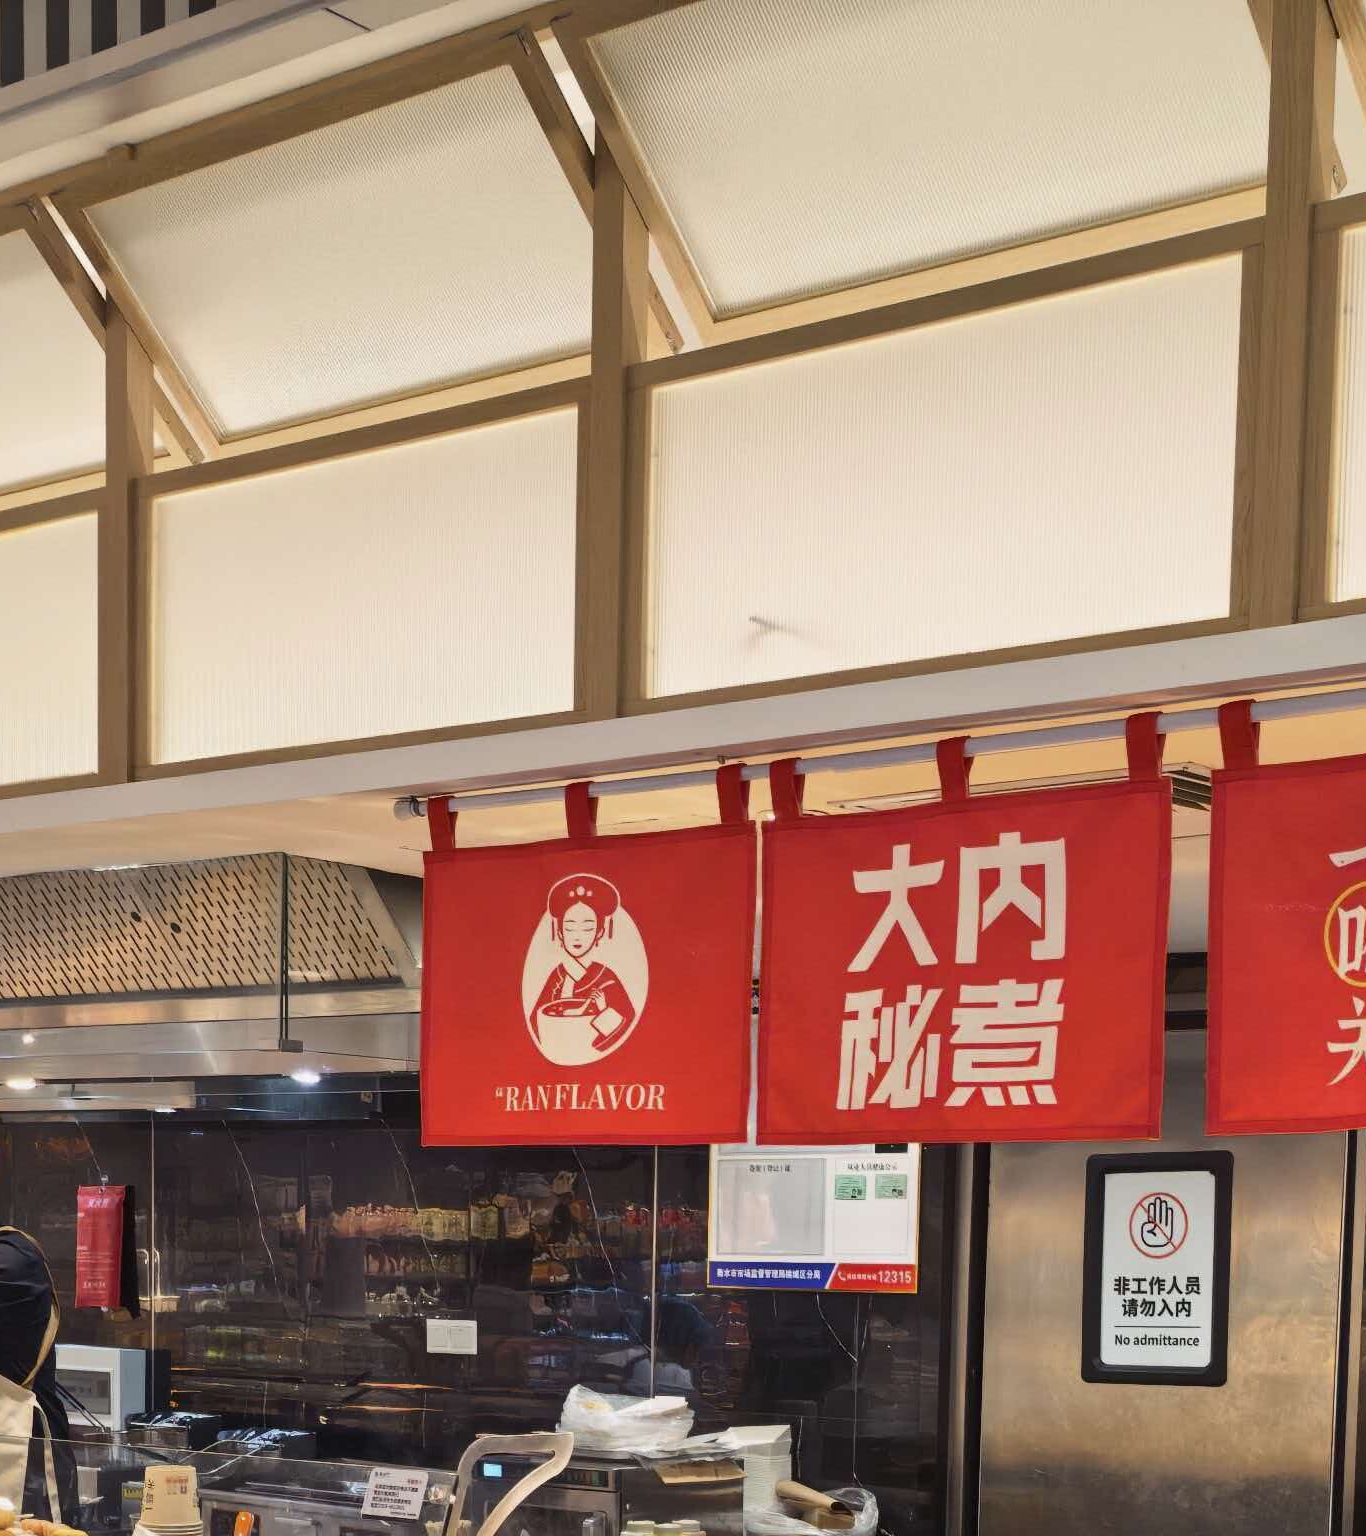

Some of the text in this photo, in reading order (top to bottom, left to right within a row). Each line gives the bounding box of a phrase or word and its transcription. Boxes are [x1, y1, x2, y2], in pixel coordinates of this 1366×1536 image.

[849, 830, 1067, 972] 大内
[836, 980, 1065, 1110] 秘煮
[878, 1270, 912, 1284] 12315
[1114, 1276, 1201, 1296] 非工作人员
[1122, 1298, 1192, 1318] 请勿入内
[1115, 1334, 1200, 1347] No admittance
